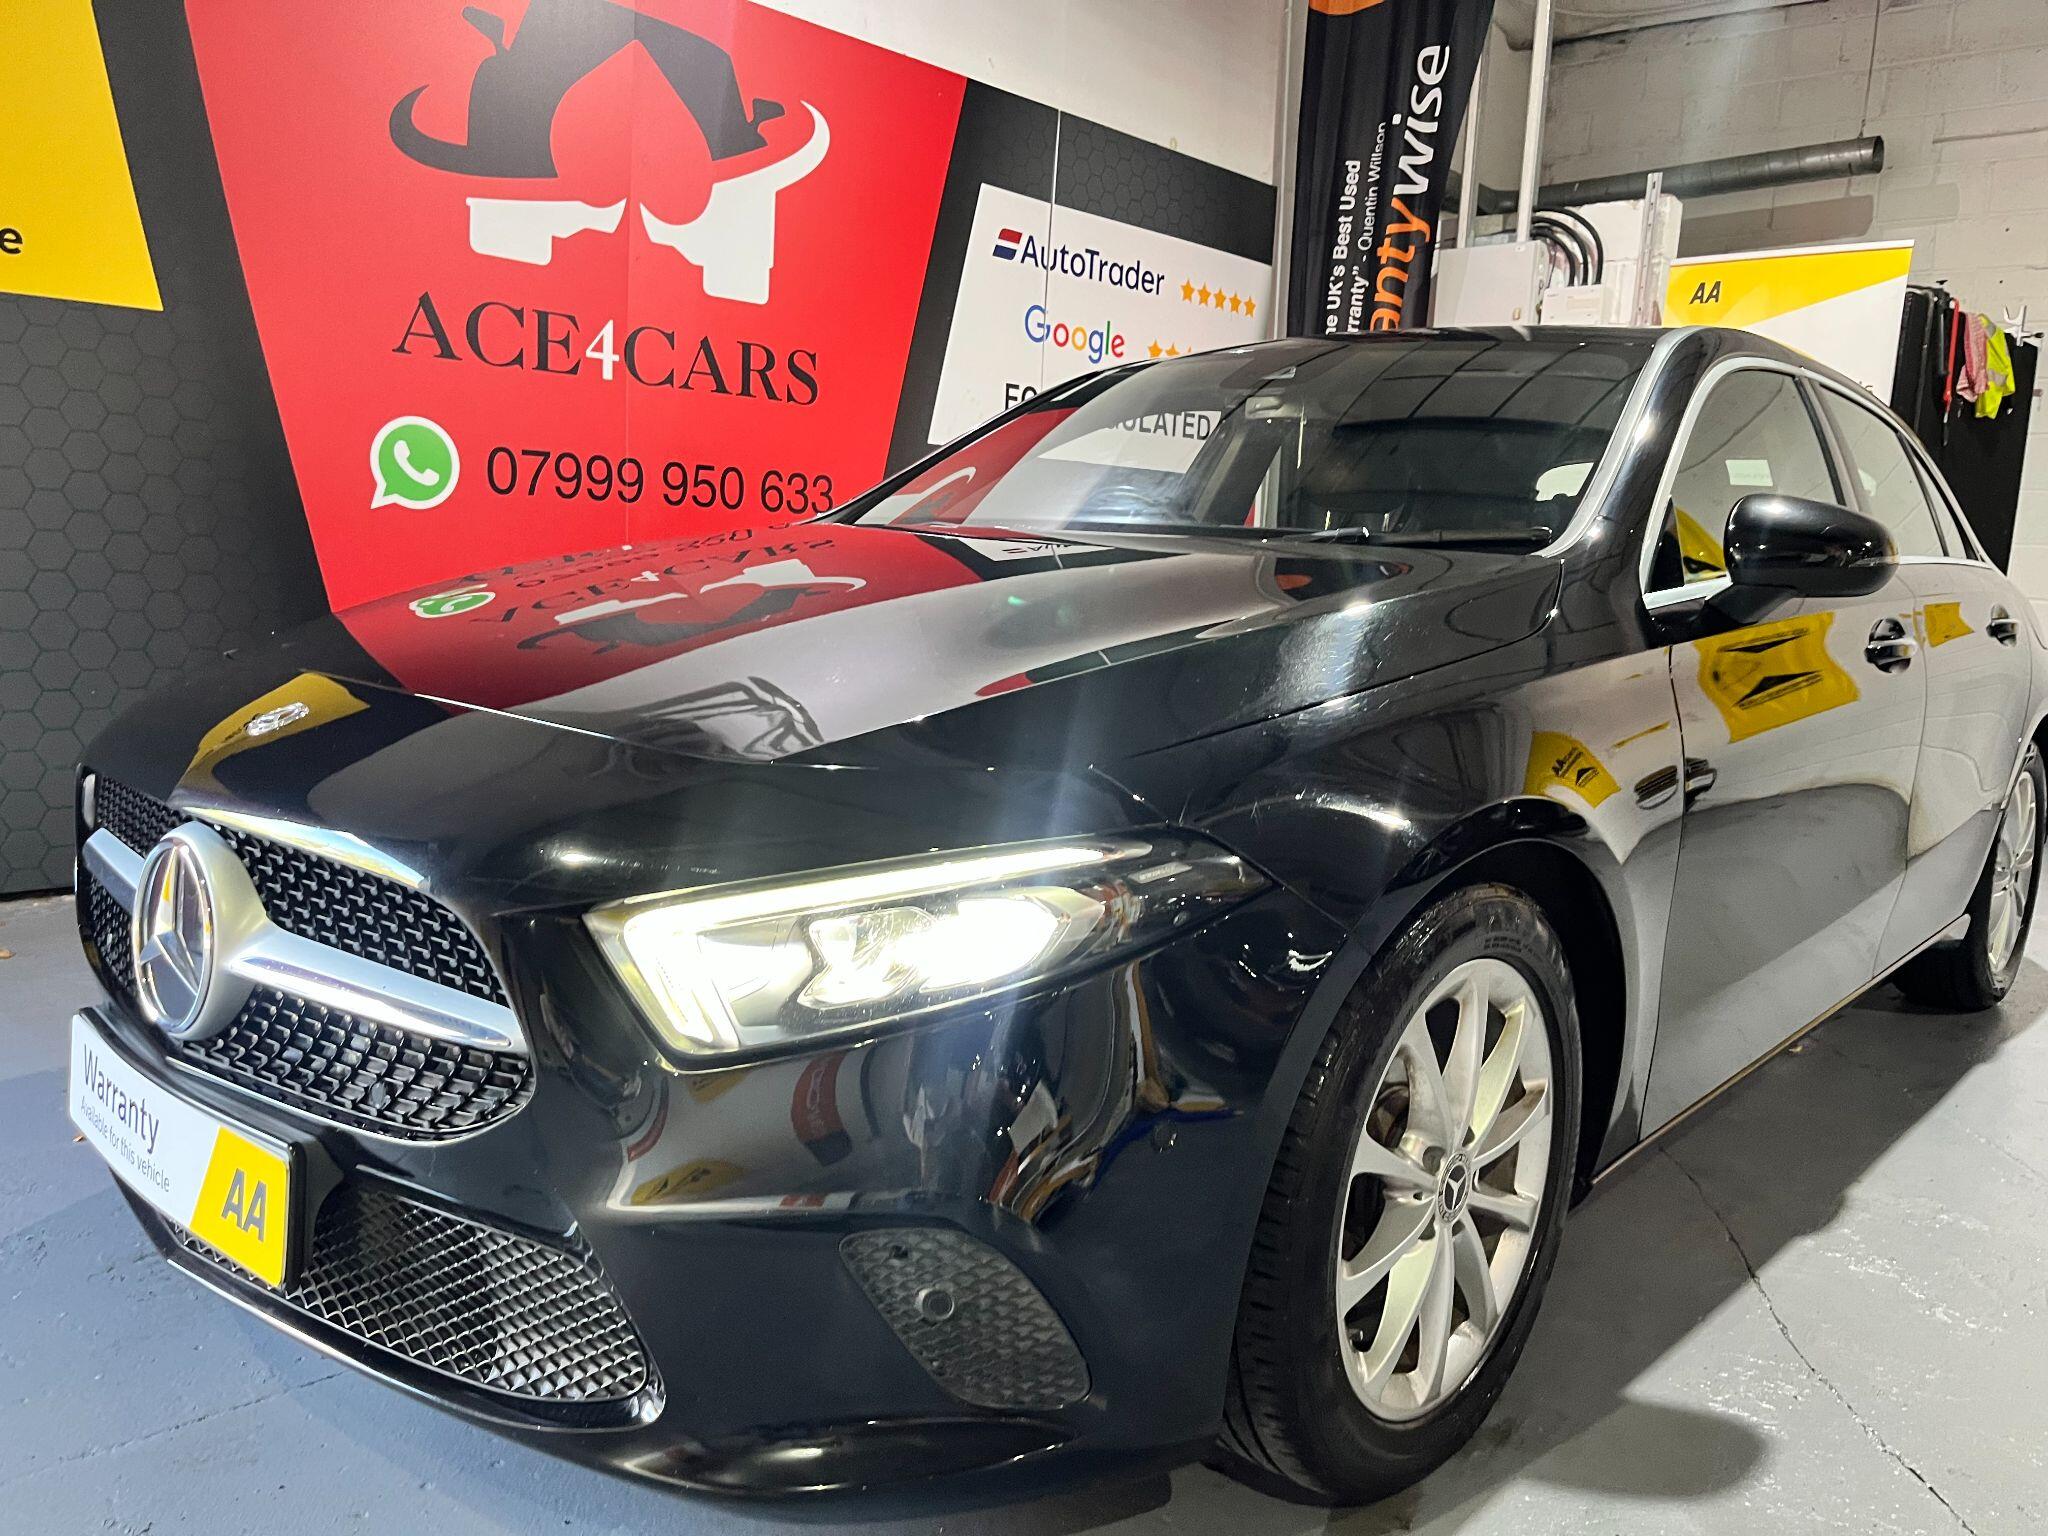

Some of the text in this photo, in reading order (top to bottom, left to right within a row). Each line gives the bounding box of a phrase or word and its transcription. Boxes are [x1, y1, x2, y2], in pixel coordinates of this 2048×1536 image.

[1367, 122, 1386, 183] Willson
[1339, 160, 1361, 212] Used
[1332, 215, 1353, 260] Best
[1358, 187, 1378, 250] Quentin
[1020, 235, 1165, 295] AutoTrader
[1326, 265, 1345, 310] UK's
[1689, 280, 1722, 305] AA
[392, 291, 819, 406] ACE4CARS
[1024, 304, 1125, 364] Google
[486, 446, 834, 515] 07999 950 633
[83, 1044, 160, 1154] Warranty
[80, 1096, 170, 1193] Available for this vehicle
[221, 1167, 267, 1242] AA
